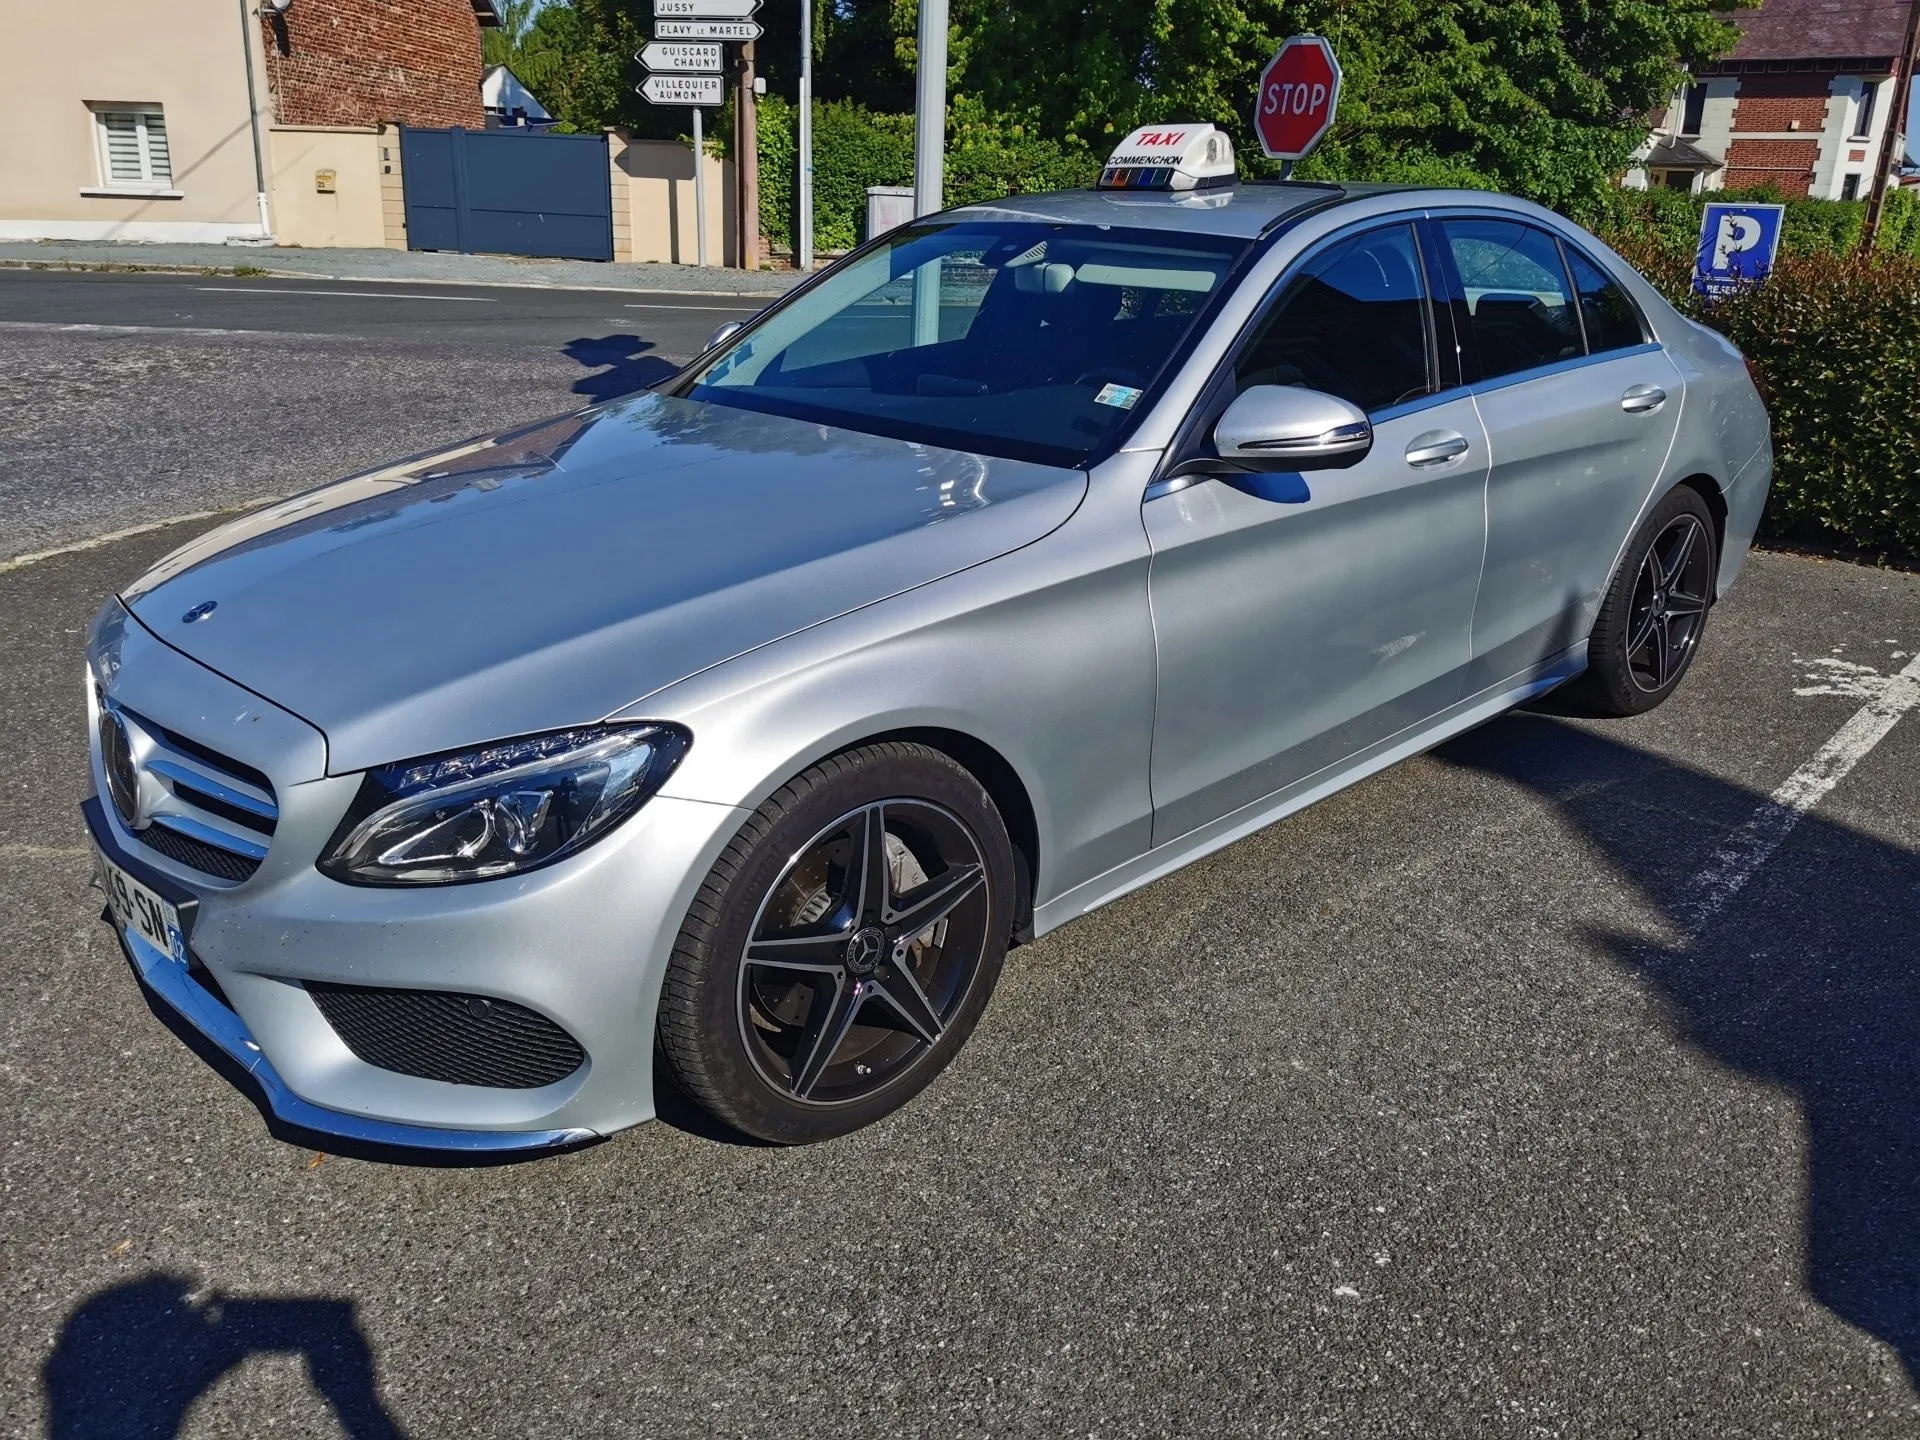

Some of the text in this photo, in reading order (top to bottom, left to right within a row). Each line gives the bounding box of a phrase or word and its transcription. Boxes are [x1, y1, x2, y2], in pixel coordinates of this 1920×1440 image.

[660, 3, 694, 12] JUSSY
[660, 25, 692, 35] FLAVY
[709, 26, 752, 36] MARTEL
[661, 47, 717, 57] GUISCARD
[674, 58, 717, 67] CHAUNY
[654, 80, 718, 90] VILLEQUIER
[654, 91, 703, 100] -AUMONT
[1264, 83, 1326, 115] STOP
[1136, 132, 1186, 146] TAXI
[1107, 155, 1184, 166] COMMENCHON
[1712, 215, 1761, 270] P
